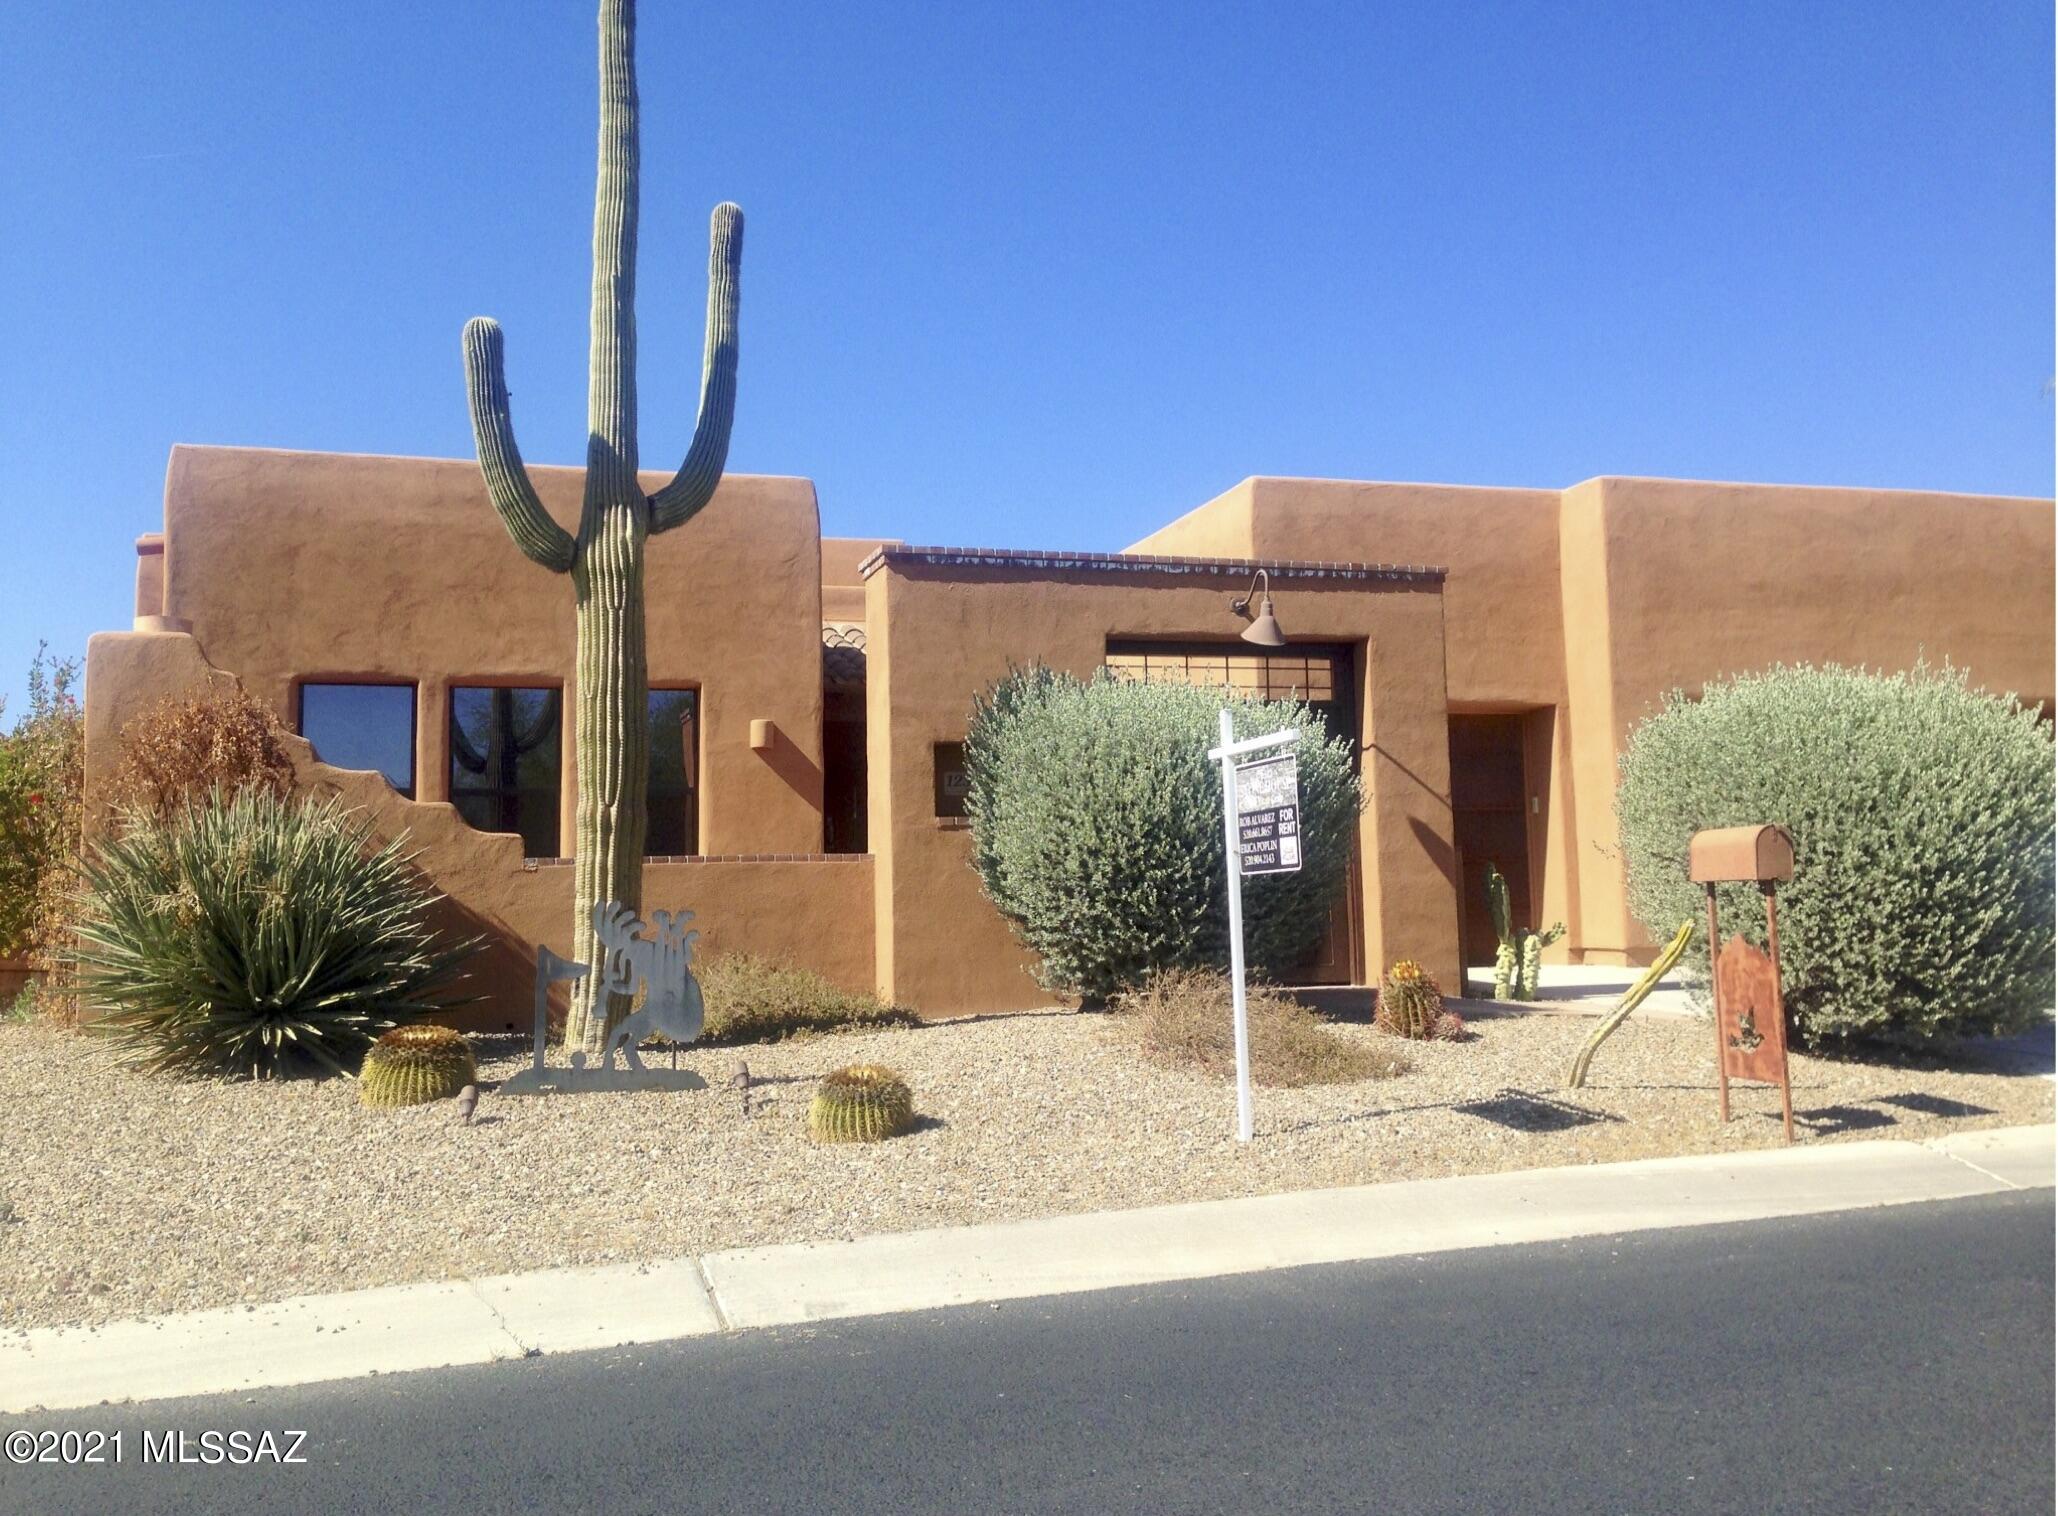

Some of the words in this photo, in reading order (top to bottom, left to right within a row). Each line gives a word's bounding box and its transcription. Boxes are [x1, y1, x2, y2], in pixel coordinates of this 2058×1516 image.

[1251, 812, 1275, 825] ALVAREZ
[1279, 808, 1294, 821] FOR
[1278, 821, 1296, 835] RENT
[1240, 843, 1256, 854] ERICA
[1257, 840, 1278, 852] POPLIN
